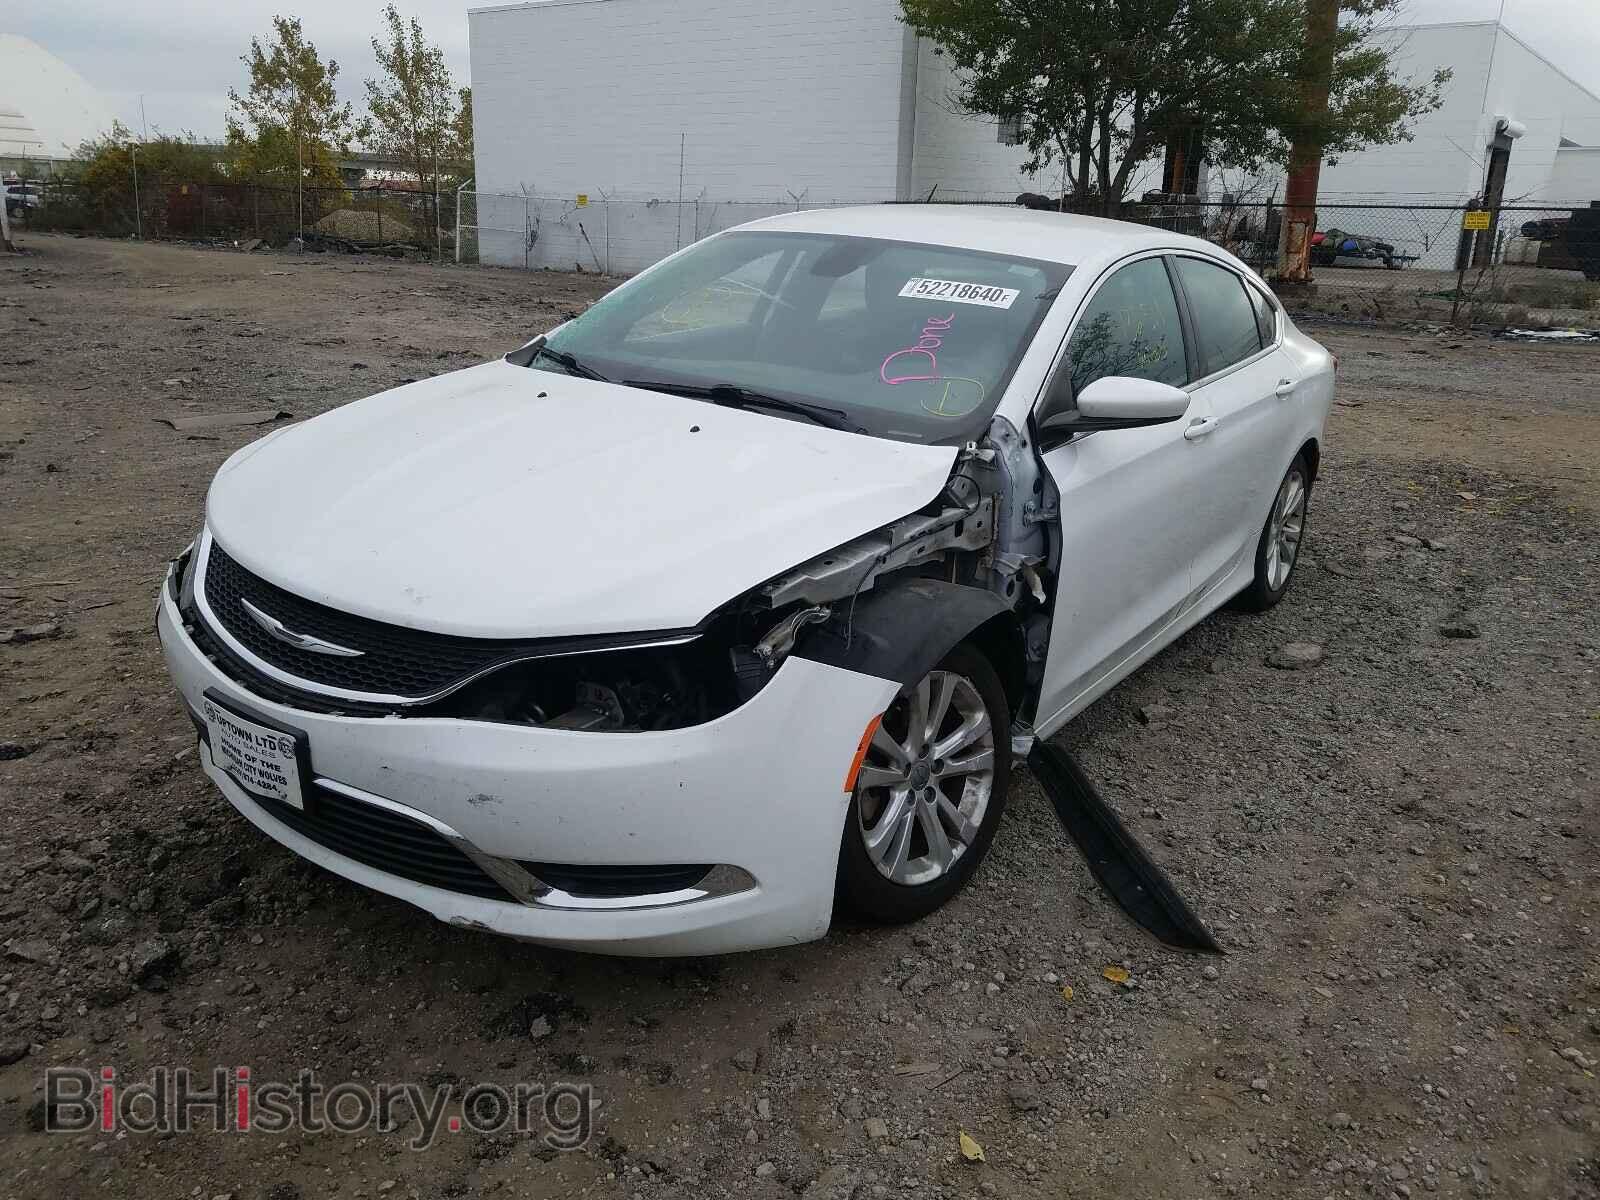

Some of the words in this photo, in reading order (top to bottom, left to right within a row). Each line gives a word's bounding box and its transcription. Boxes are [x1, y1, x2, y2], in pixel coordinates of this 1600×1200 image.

[881, 312, 956, 385] Done
[216, 710, 253, 743] UPTOWN
[243, 743, 277, 759] SALES
[244, 753, 257, 763] OF
[260, 760, 282, 773] THE
[257, 768, 288, 786] WOLVES
